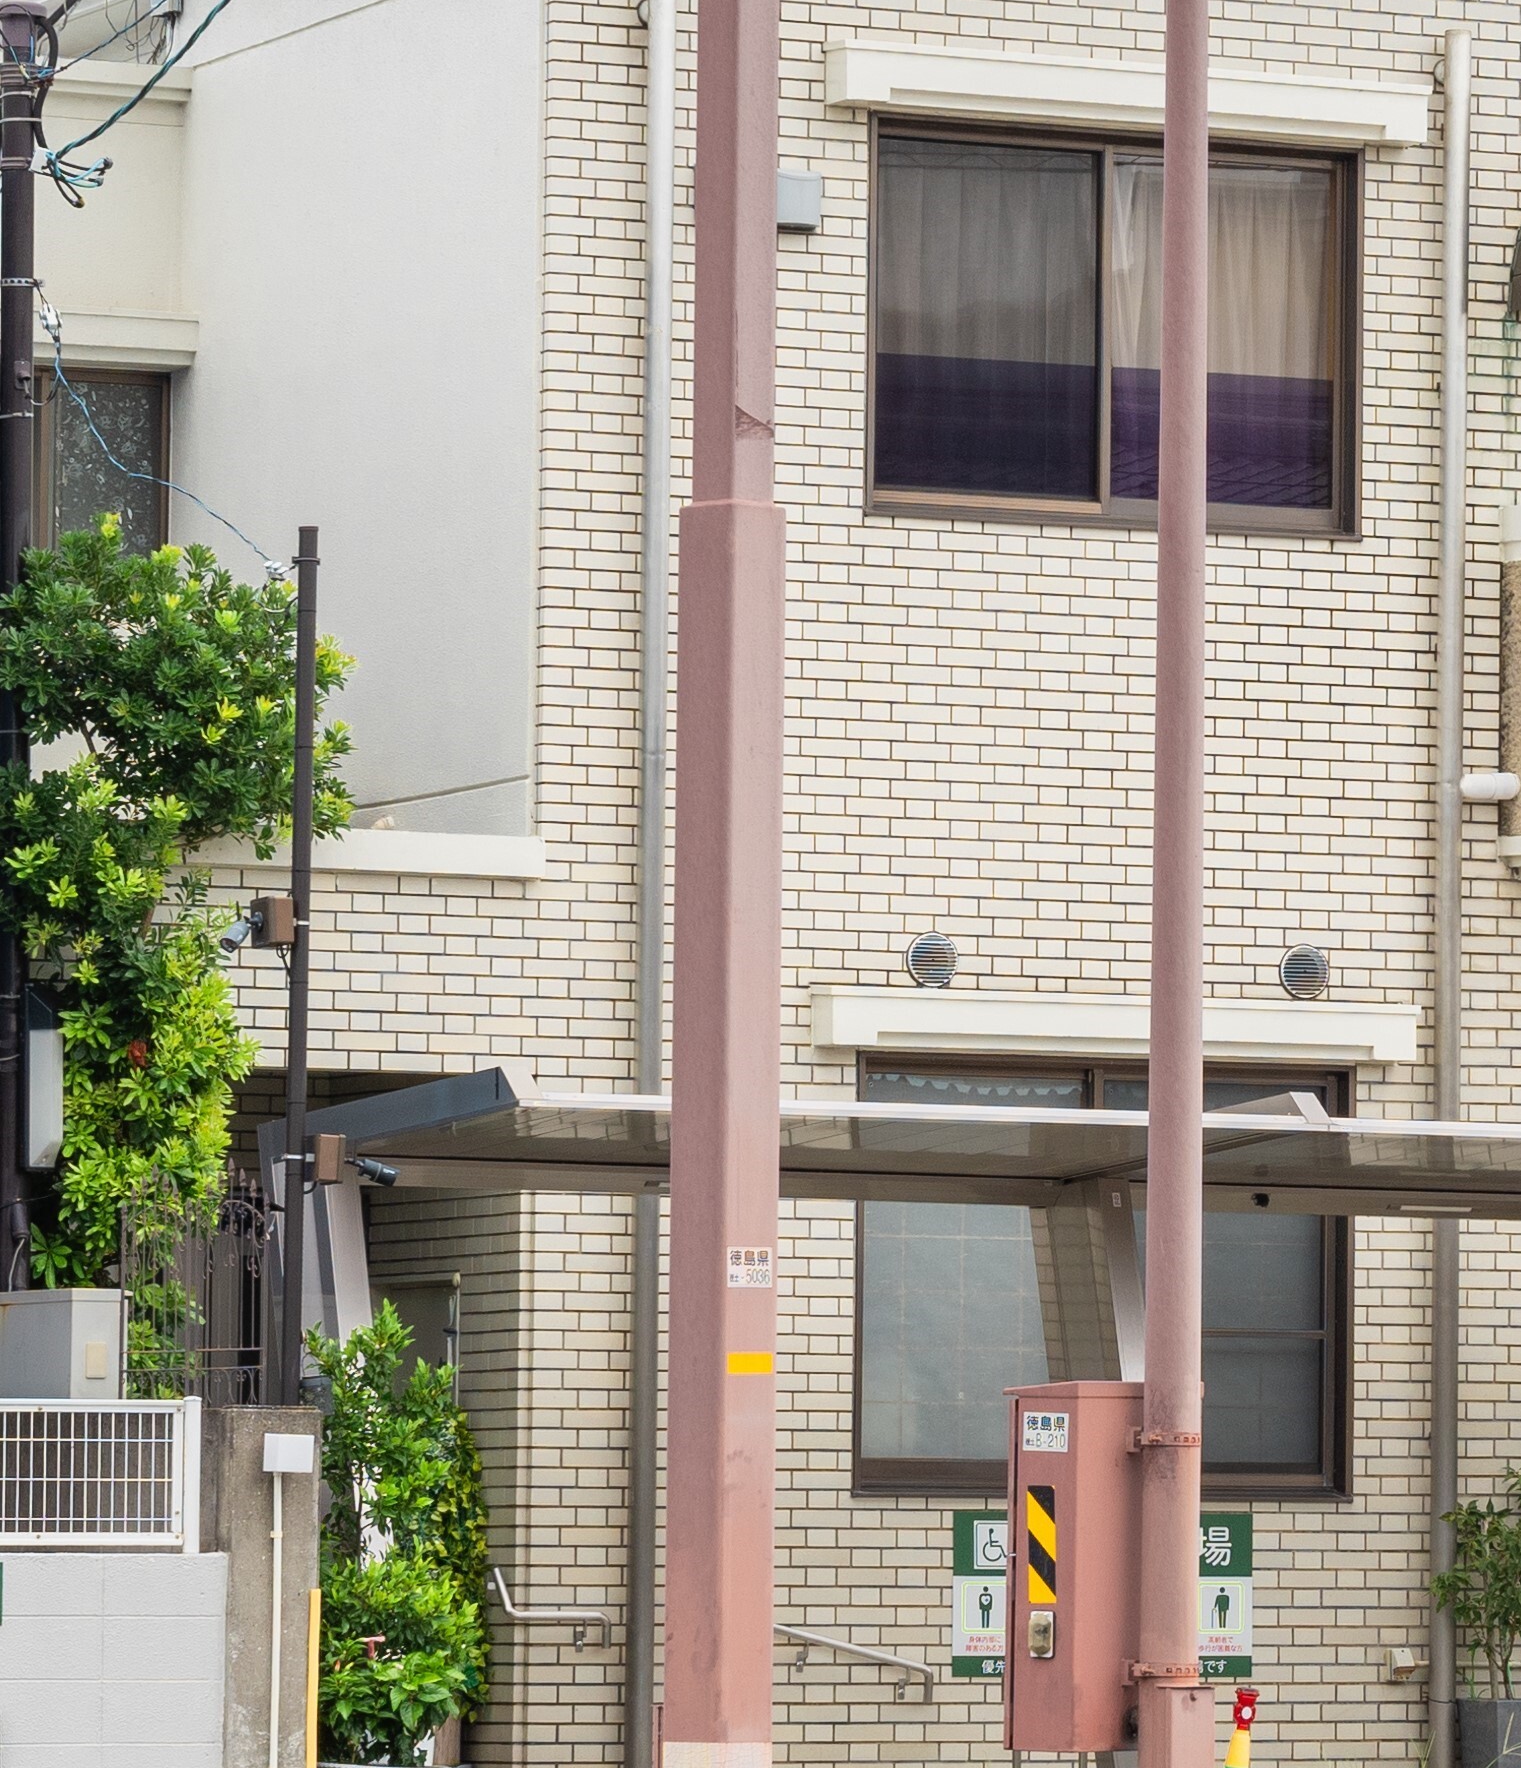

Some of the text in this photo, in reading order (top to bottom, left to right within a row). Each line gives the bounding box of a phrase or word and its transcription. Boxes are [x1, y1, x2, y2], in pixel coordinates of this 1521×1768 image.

[729, 1250, 769, 1266] 徳島県
[1026, 1415, 1065, 1432] 徳島県
[1199, 1527, 1232, 1566] 場
